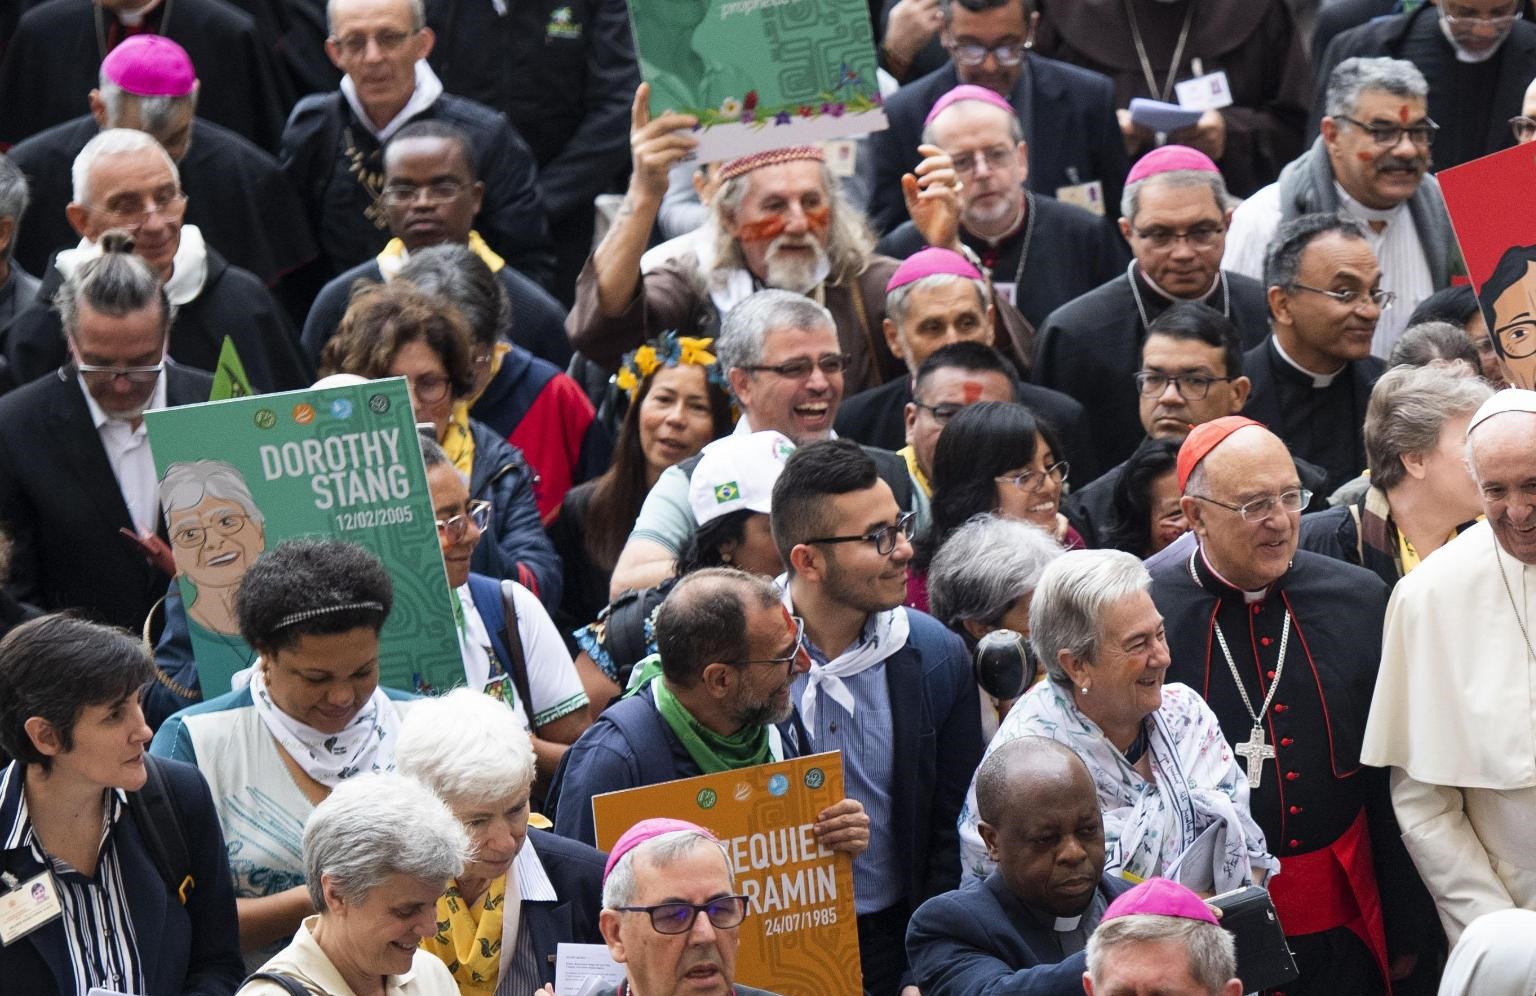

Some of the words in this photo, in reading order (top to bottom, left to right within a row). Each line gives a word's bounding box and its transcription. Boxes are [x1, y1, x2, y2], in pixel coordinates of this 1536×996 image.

[260, 428, 400, 481] DOROTHY
[311, 464, 410, 509] STANG
[336, 505, 413, 531] 12/02/2005
[742, 864, 837, 917] RAMIN
[765, 907, 837, 936] 24/07/1985
